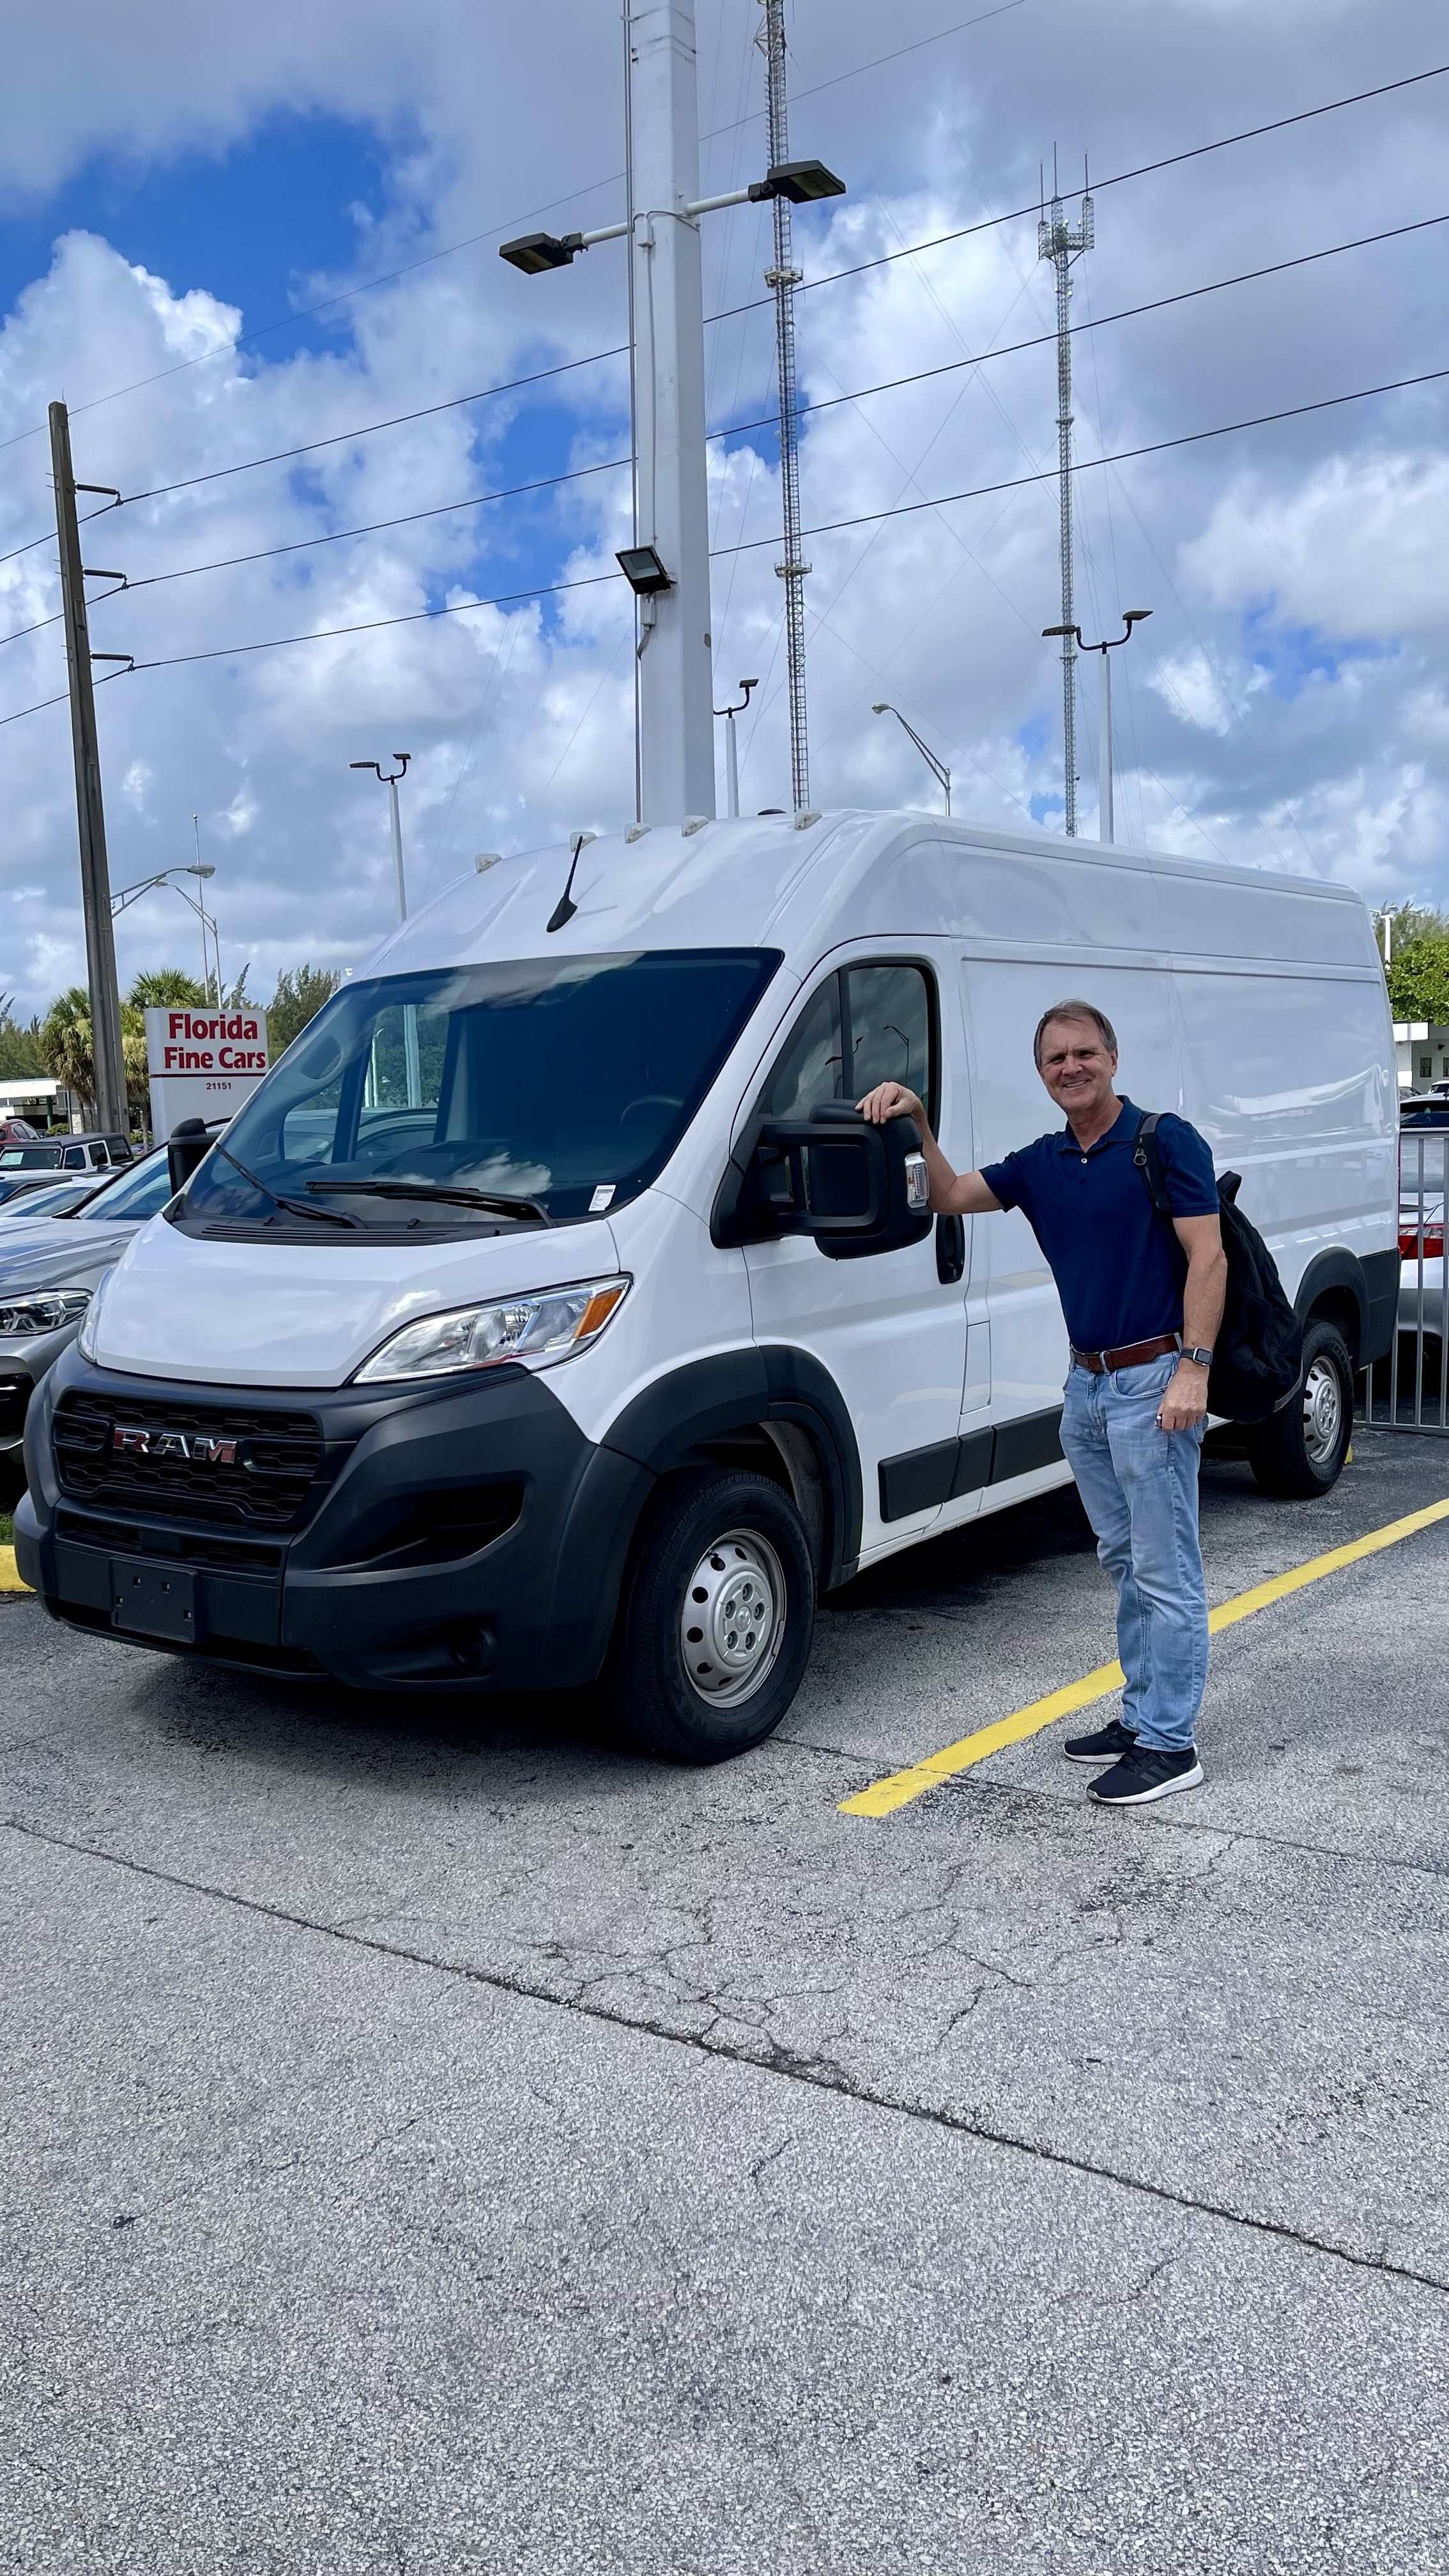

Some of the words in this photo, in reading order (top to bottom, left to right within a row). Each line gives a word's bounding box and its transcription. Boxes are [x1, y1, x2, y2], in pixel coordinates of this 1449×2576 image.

[169, 1013, 258, 1039] Florida
[164, 1046, 213, 1069] Fine
[218, 1046, 266, 1069] Cars
[114, 1427, 237, 1464] RAM
